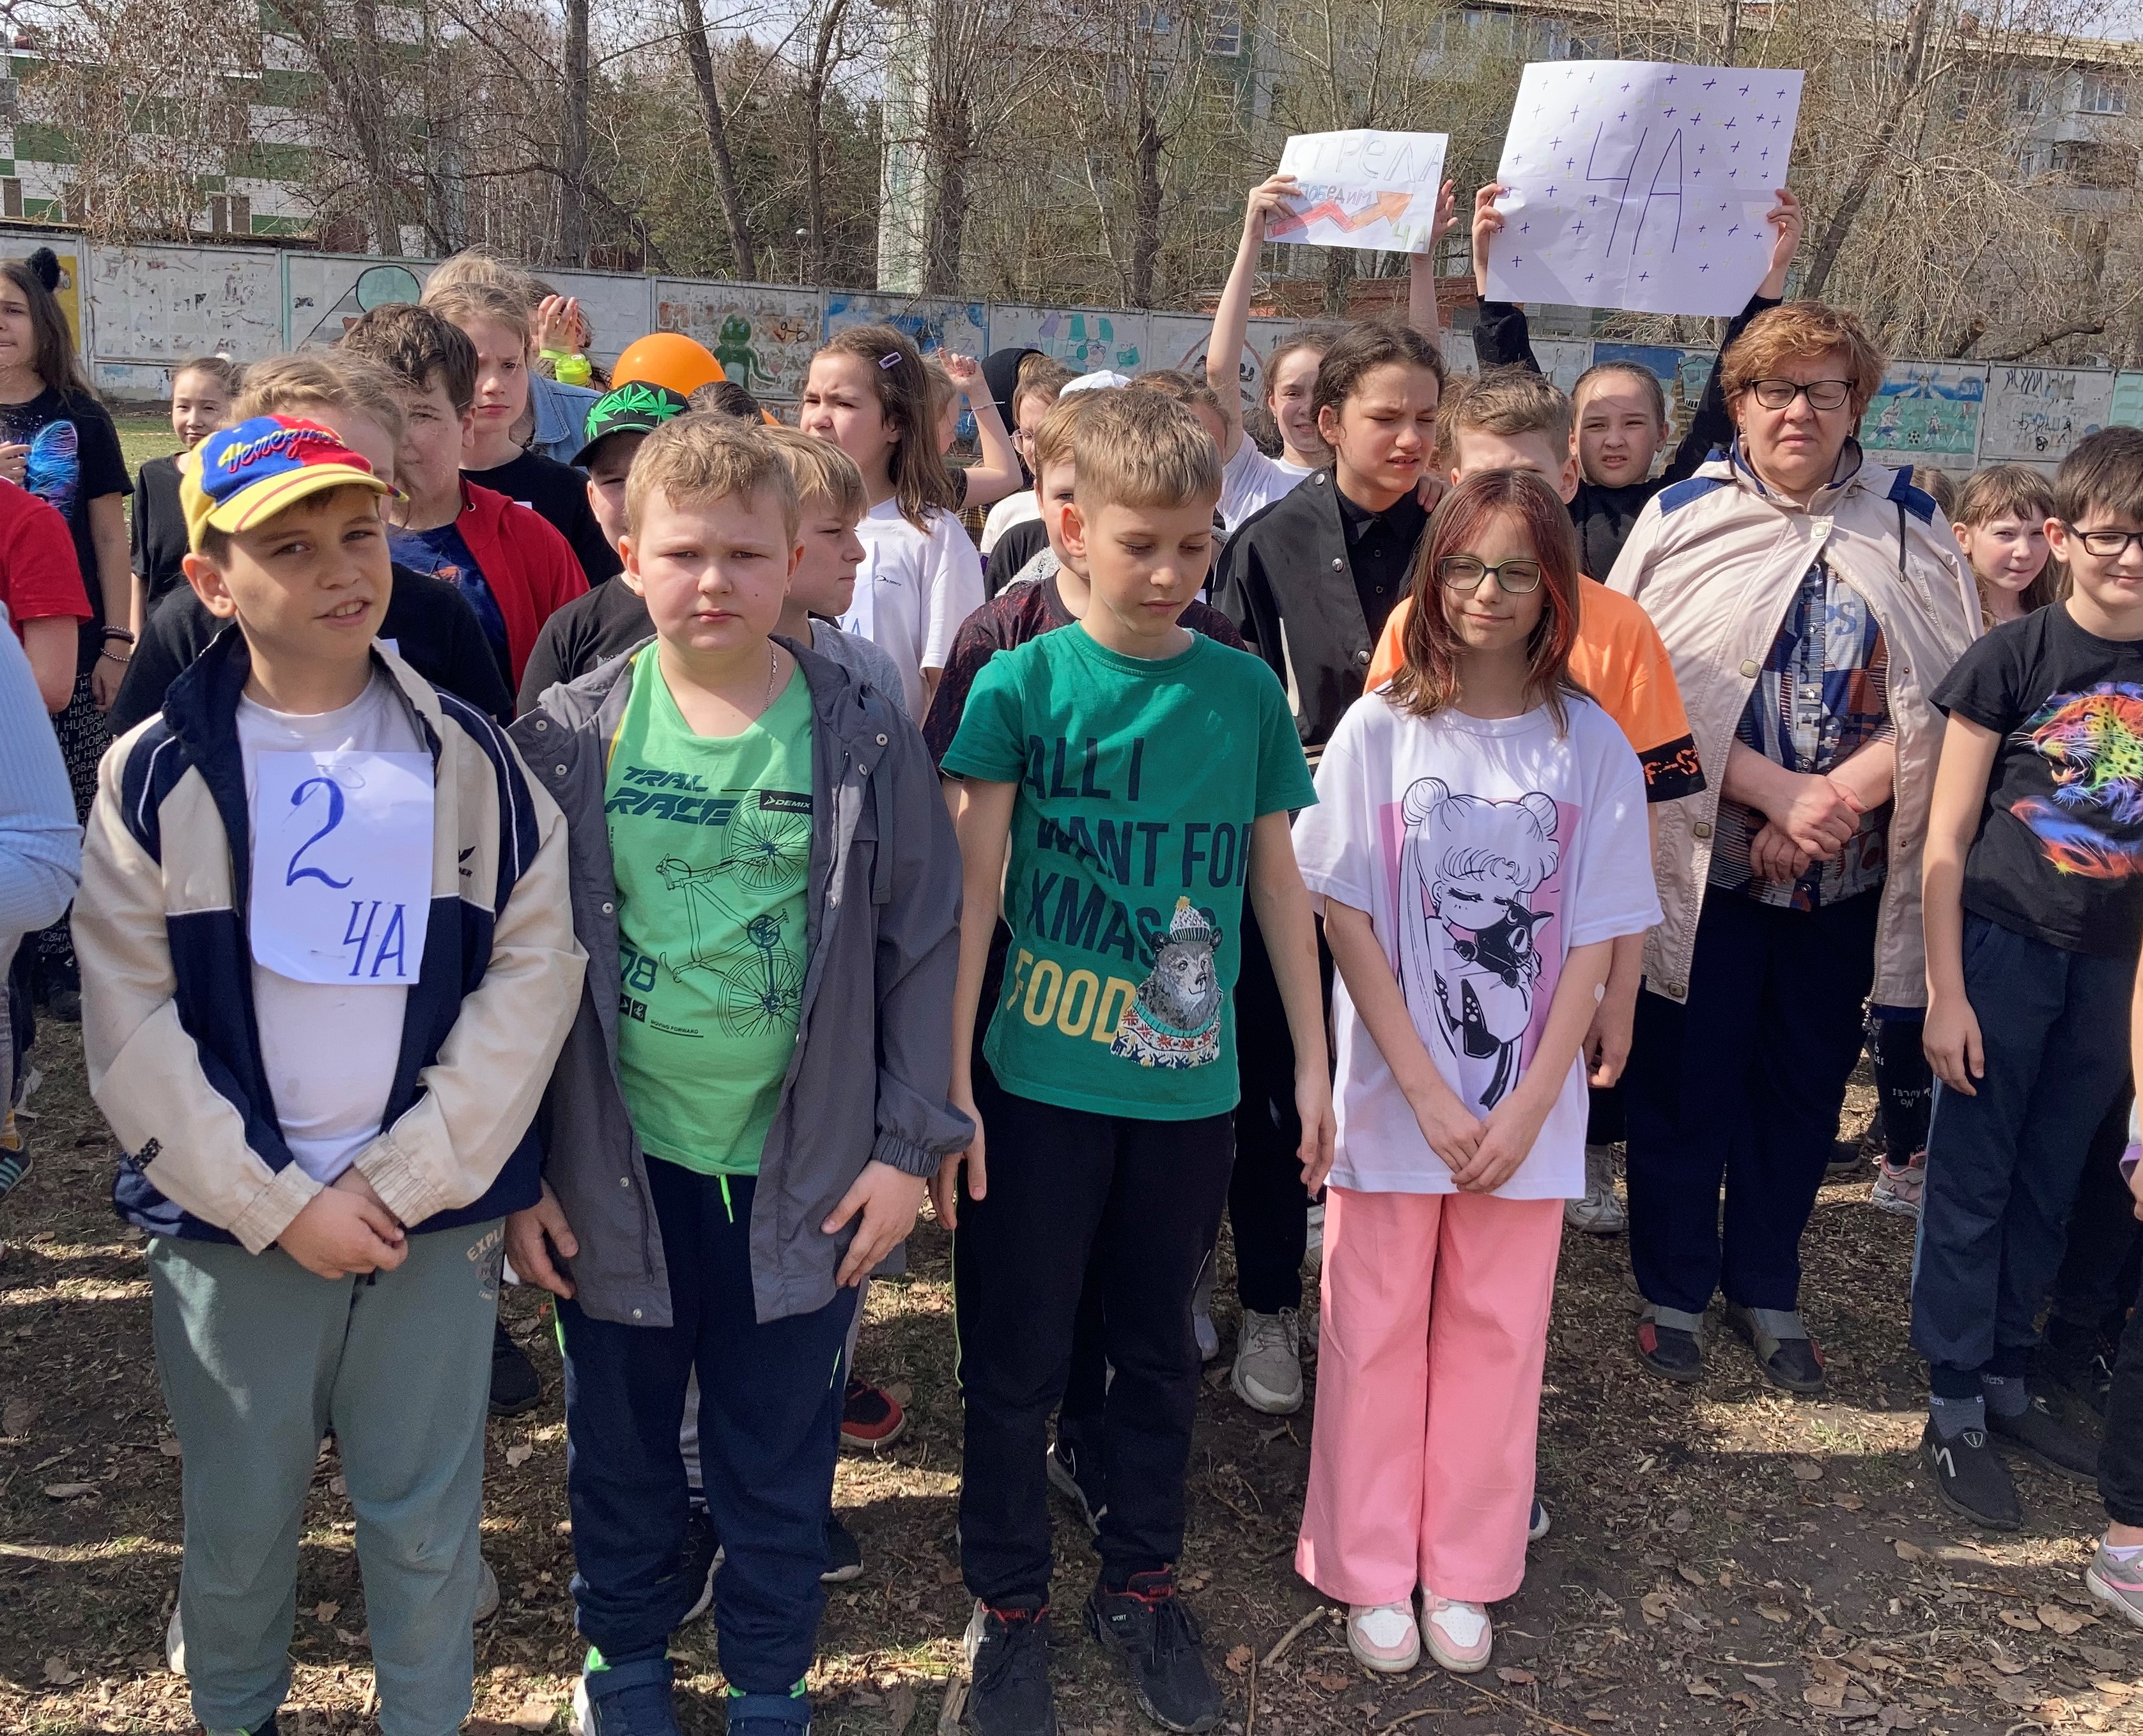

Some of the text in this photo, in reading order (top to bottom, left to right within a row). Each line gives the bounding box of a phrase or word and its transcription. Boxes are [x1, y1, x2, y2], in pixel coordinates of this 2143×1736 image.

[775, 798, 811, 809] DEMIX
[1024, 734, 1145, 802] ALL I
[286, 777, 354, 889] 2
[604, 787, 740, 826] RACE
[1037, 816, 1170, 887] WANT
[342, 900, 407, 978] 4А
[1027, 868, 1161, 970] XMAS
[670, 1025, 699, 1034] FORWARD
[1006, 947, 1137, 1044] FOOD
